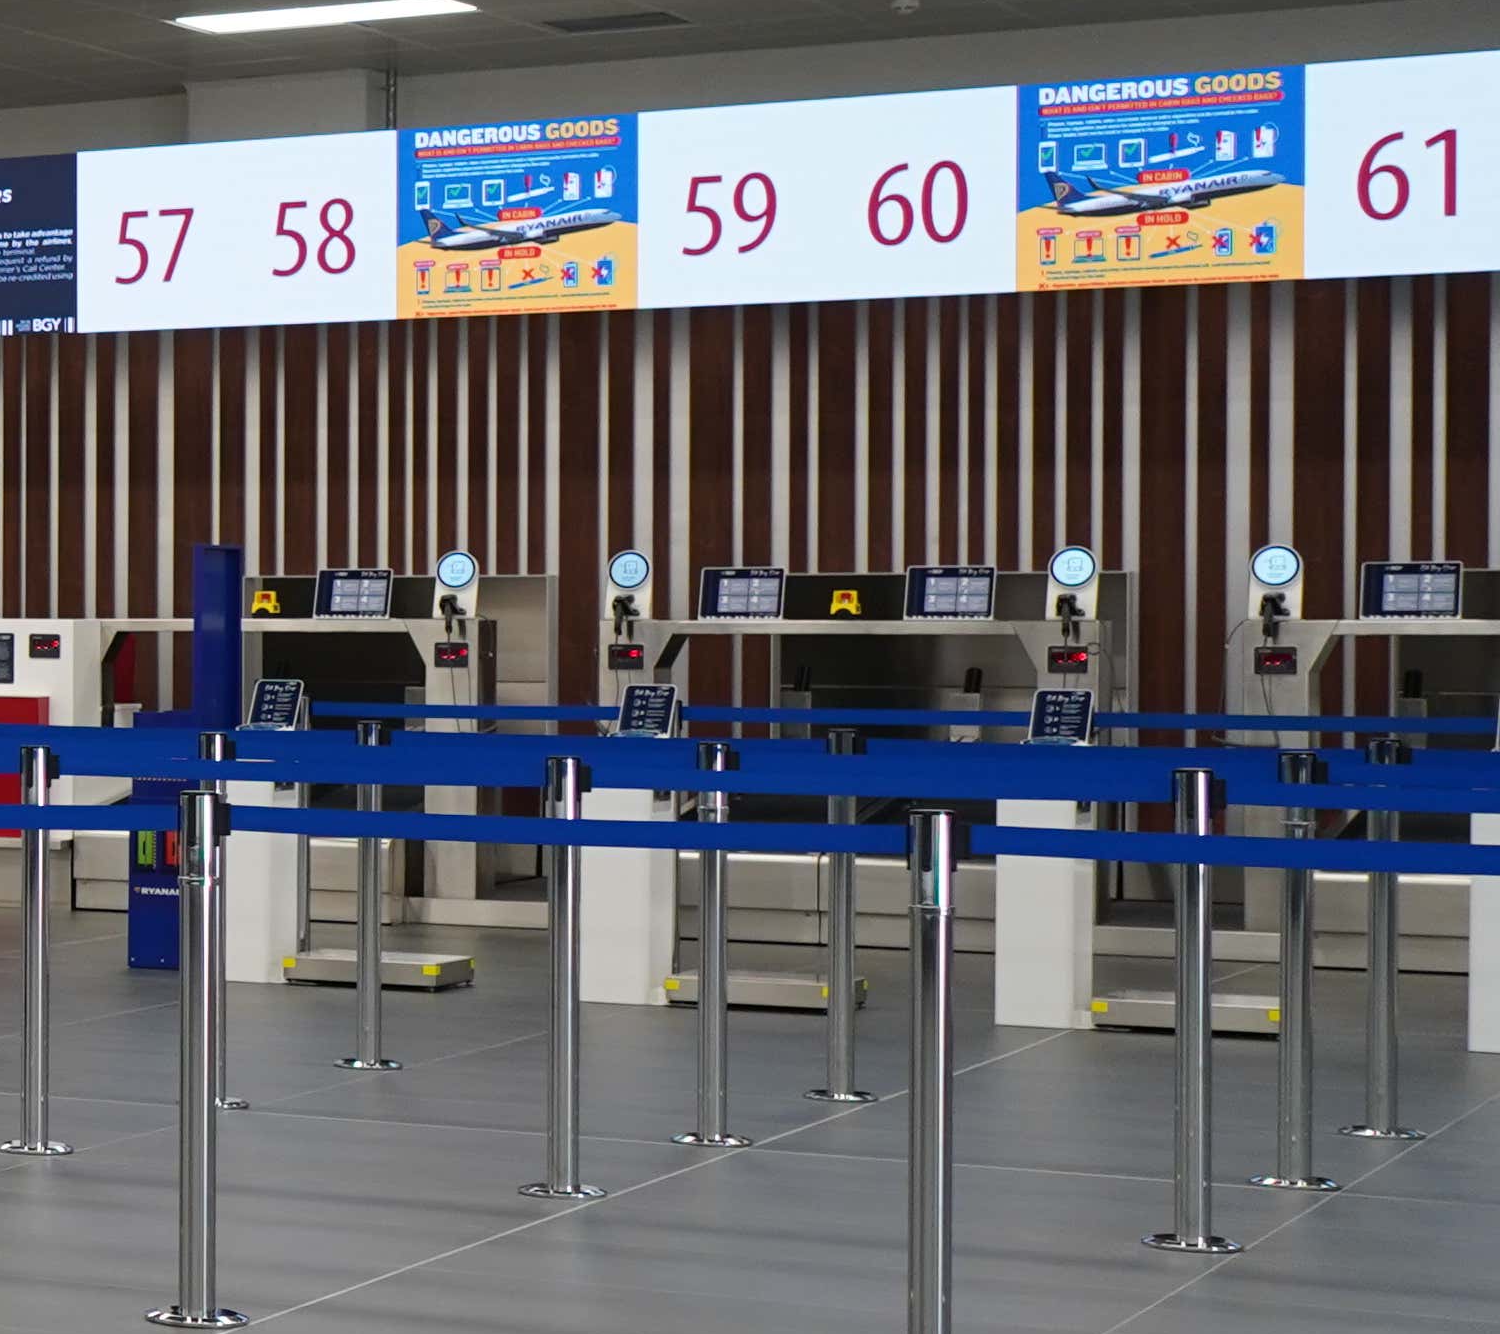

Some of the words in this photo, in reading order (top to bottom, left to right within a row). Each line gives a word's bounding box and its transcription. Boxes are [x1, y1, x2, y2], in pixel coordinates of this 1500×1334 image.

[1038, 77, 1189, 105] DANGEROUS
[1194, 71, 1281, 95] GOODS
[415, 124, 541, 149] DANGEROUS
[545, 118, 619, 140] GOODS
[1143, 173, 1151, 181] IN
[1153, 172, 1183, 181] CABIN
[1159, 175, 1239, 197] RYANAIR
[1357, 129, 1457, 221] 61
[682, 172, 777, 256] 59
[868, 160, 968, 246] 60
[1144, 215, 1153, 223] IN
[1155, 213, 1182, 223] HOLD
[516, 214, 583, 234] RYANAIR
[115, 208, 194, 284] 57
[272, 198, 356, 277] 58
[33, 318, 61, 332] BGY
